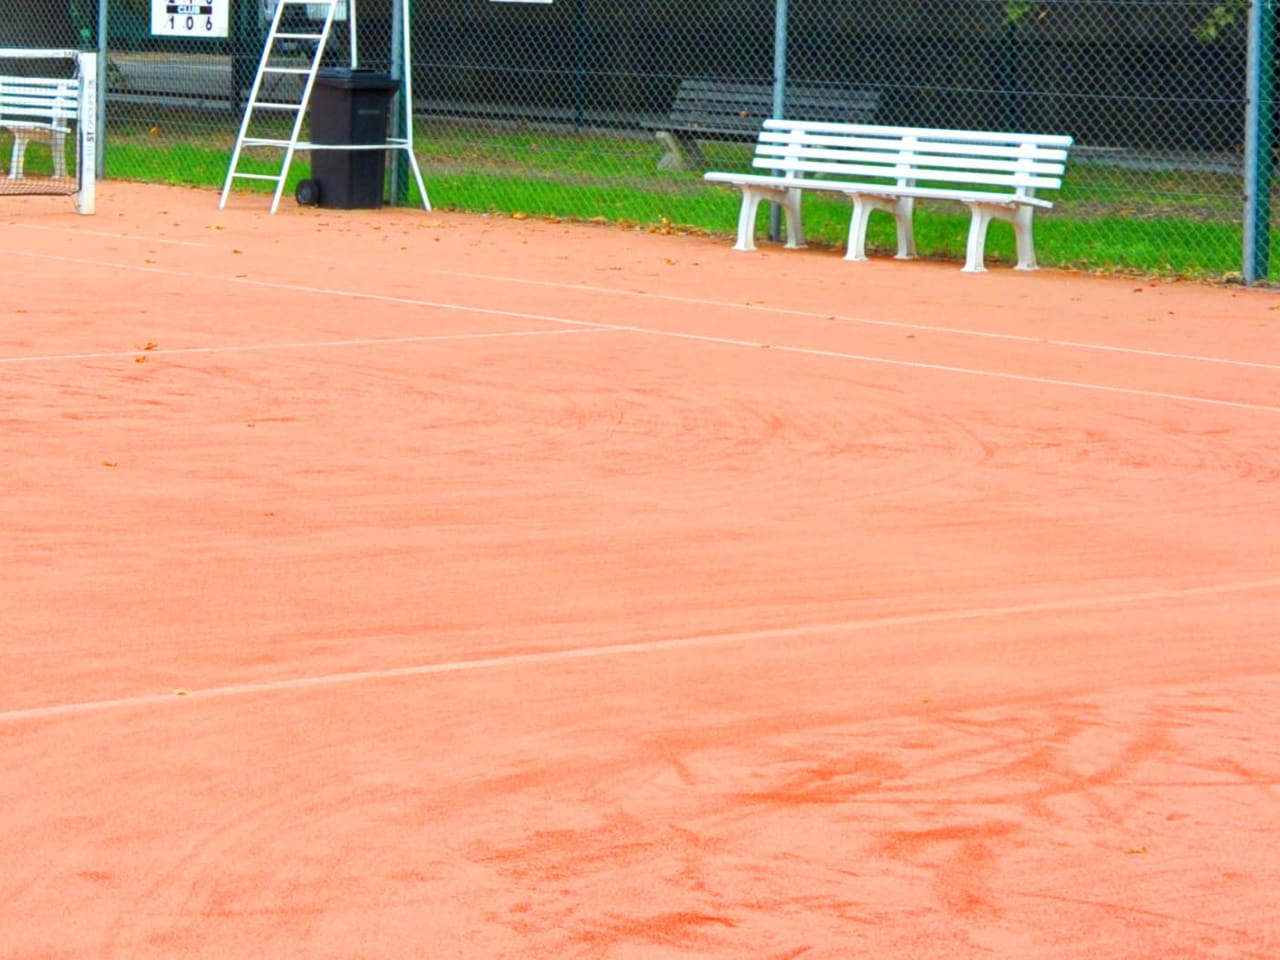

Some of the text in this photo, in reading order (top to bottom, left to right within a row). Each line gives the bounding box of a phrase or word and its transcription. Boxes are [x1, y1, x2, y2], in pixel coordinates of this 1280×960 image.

[169, 15, 212, 31] 1 0 6
